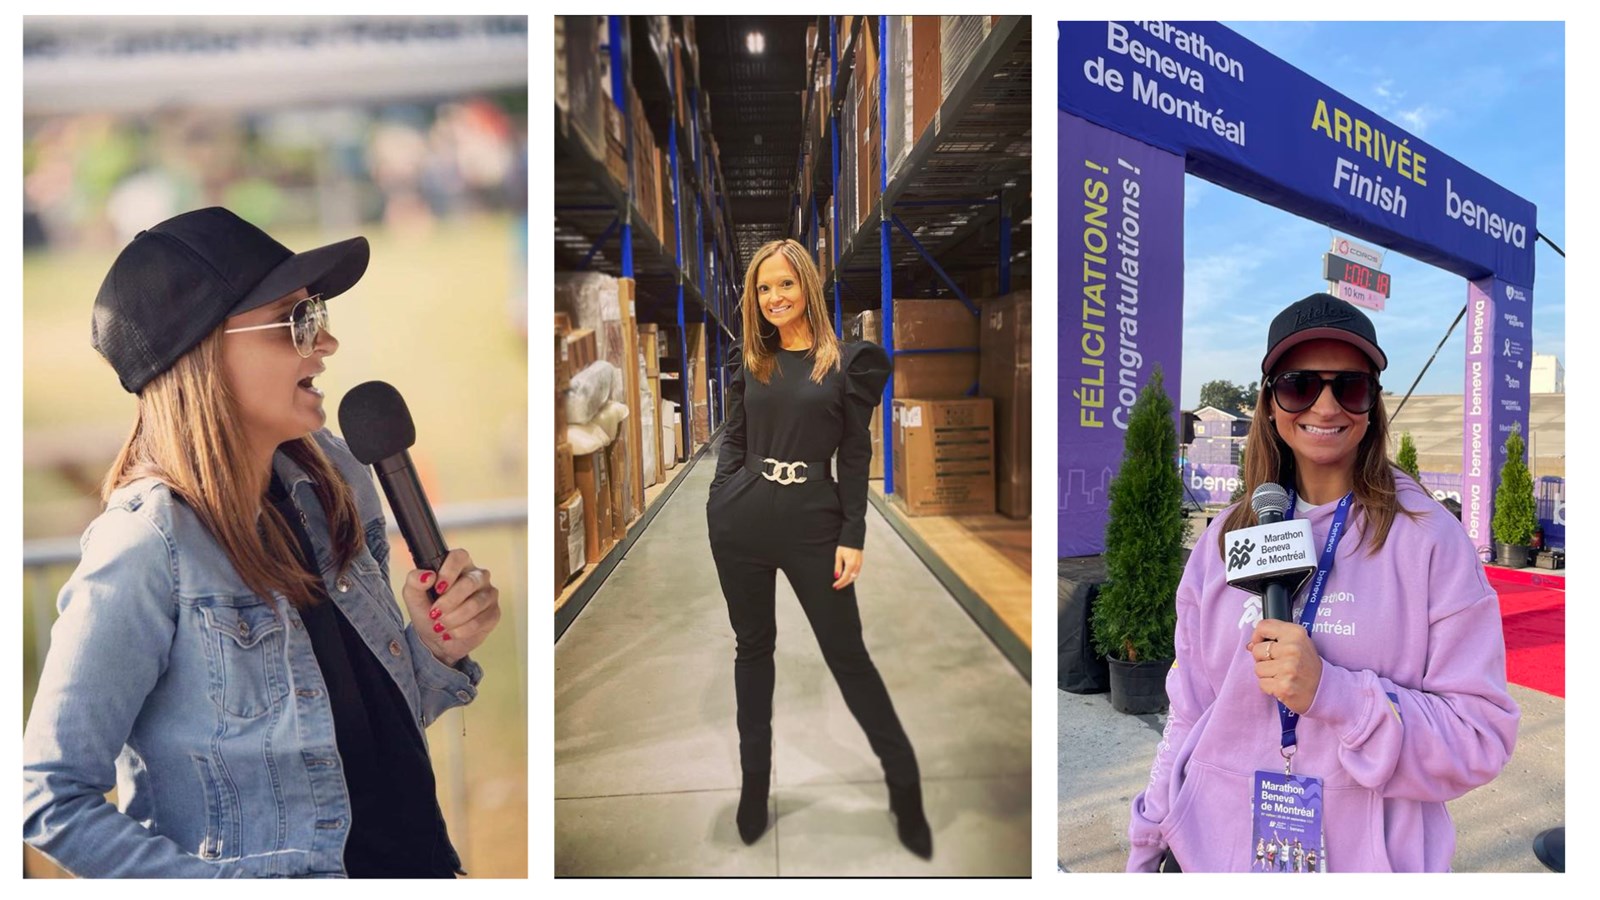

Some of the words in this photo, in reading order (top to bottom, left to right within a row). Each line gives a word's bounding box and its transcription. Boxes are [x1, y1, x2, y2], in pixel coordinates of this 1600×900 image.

[1107, 21, 1204, 93] Beneva
[1083, 56, 1125, 93] de
[1132, 71, 1246, 147] Montréal
[1311, 98, 1427, 187] ARRIVÉE
[1333, 156, 1408, 219] Finish
[1446, 178, 1526, 249] beneva
[1349, 248, 1378, 263] COROS
[1344, 287, 1352, 297] 10
[1353, 290, 1365, 301] km
[1470, 300, 1485, 355] beneva
[1470, 362, 1482, 416] beneva
[1469, 423, 1482, 477] beneva
[1469, 485, 1480, 539] beneva
[1261, 542, 1291, 554] Beneva
[1264, 529, 1304, 543] Marathon
[1327, 522, 1341, 553] beneva
[1256, 557, 1268, 567] de
[1269, 551, 1306, 564] Montréal
[1310, 570, 1327, 603] beneva
[1312, 620, 1356, 636] ntréal
[1261, 780, 1305, 795] Marathon
[1261, 790, 1295, 804] Beneva
[1260, 801, 1273, 812] de
[1274, 803, 1315, 818] Montréal
